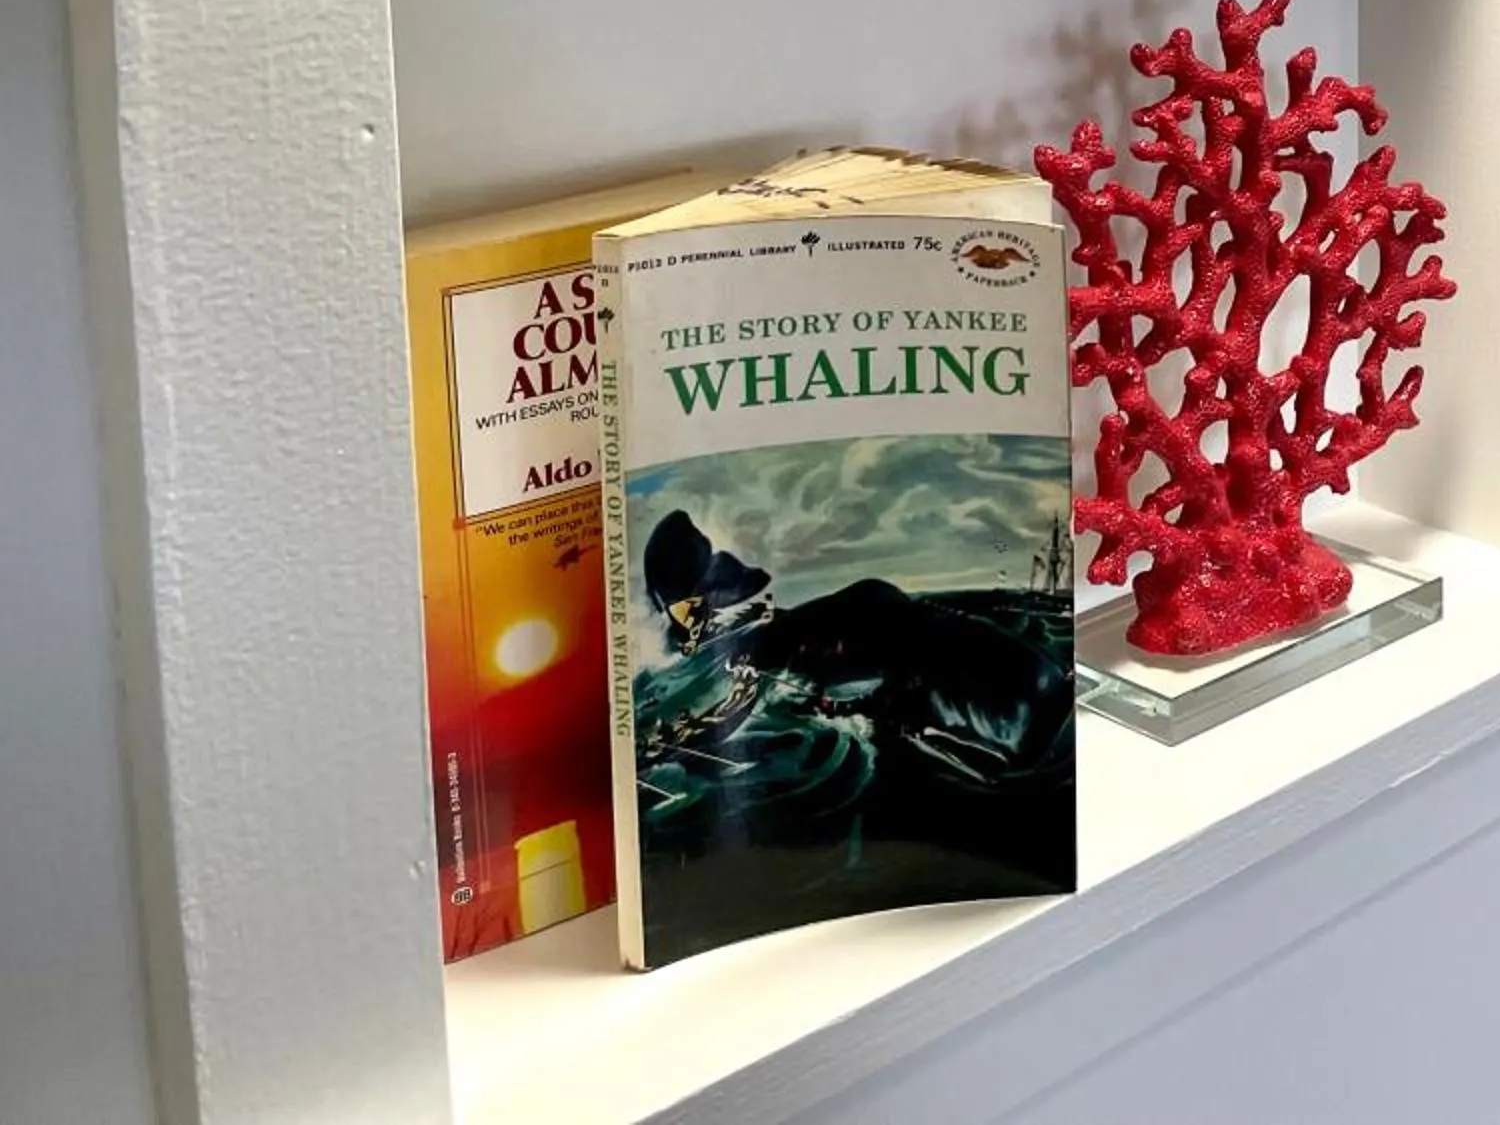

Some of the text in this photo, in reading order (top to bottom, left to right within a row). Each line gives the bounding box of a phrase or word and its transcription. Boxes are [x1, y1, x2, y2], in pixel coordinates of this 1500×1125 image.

[681, 249, 744, 263] PERENNIAL
[750, 245, 796, 256] LIBRARY
[827, 240, 905, 252] ILLUSTRATED
[534, 281, 563, 319] A
[661, 310, 1028, 351] THE STORY OF YANKEE
[664, 345, 1032, 416] WHALING
[475, 390, 598, 430] WITH ESSAYS ON
[523, 456, 593, 493] Aldo
[508, 517, 532, 529] can
[535, 506, 568, 523] place
[508, 533, 529, 546] the
[533, 518, 582, 537] writings
[601, 362, 631, 736] THE STORY OF YANKEE WHALING
